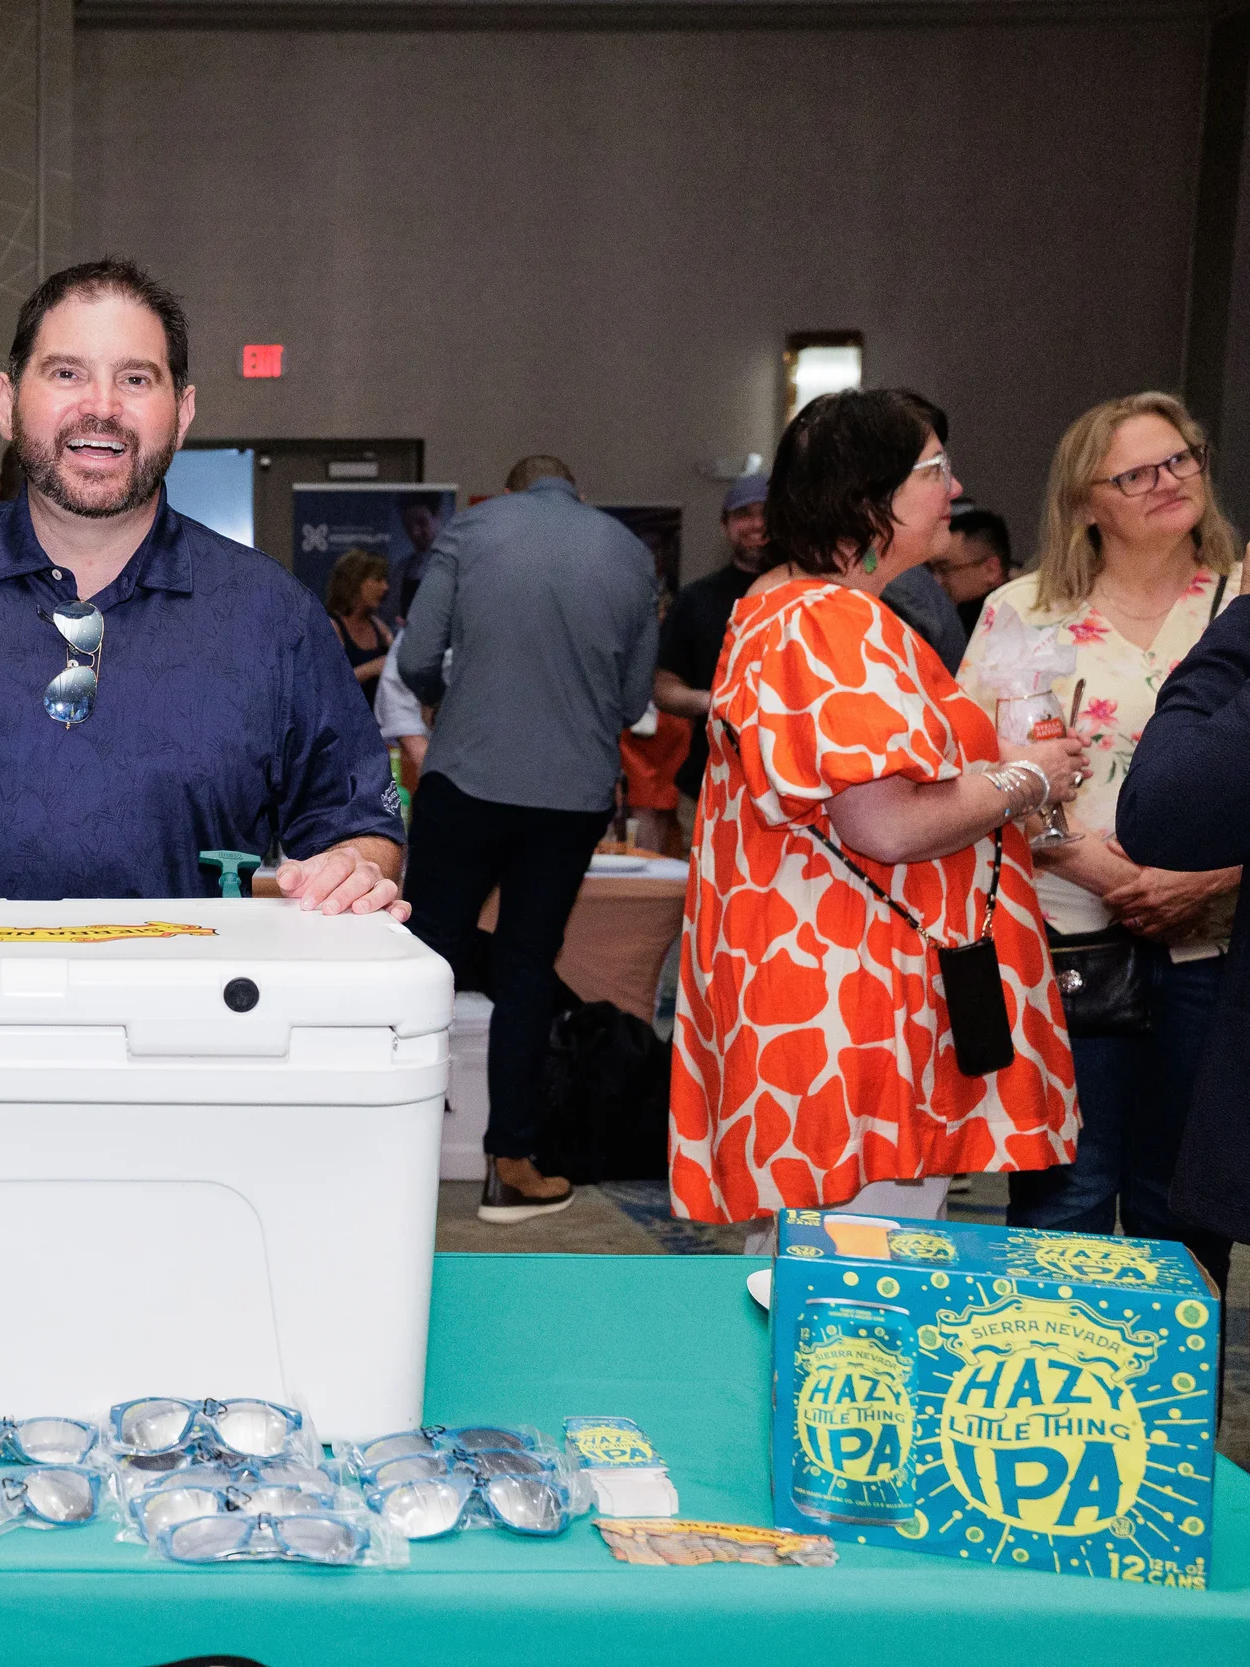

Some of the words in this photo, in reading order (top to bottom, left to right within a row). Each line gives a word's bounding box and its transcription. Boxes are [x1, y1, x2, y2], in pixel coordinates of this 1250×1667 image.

[46, 928, 165, 936] SIERRA
[786, 1209, 821, 1220] 12
[1045, 1248, 1137, 1261] HAZY
[1045, 1261, 1147, 1280] IPA
[971, 1319, 1040, 1339] SIERRA
[1045, 1321, 1121, 1354] NEVADA
[815, 1351, 853, 1361] SIERRA
[856, 1352, 897, 1369] NEVADA
[808, 1374, 902, 1405] HAZY
[955, 1357, 1124, 1411] HAZY
[804, 1407, 850, 1424] LITTLE
[848, 1404, 905, 1423] THING
[950, 1411, 1030, 1441] LITTLE
[1027, 1406, 1131, 1441] THING
[586, 1447, 648, 1460] IPA
[805, 1422, 902, 1477] IPA
[948, 1437, 1123, 1526] IPA
[1108, 1552, 1145, 1582] 12
[1148, 1570, 1205, 1591] CANS
